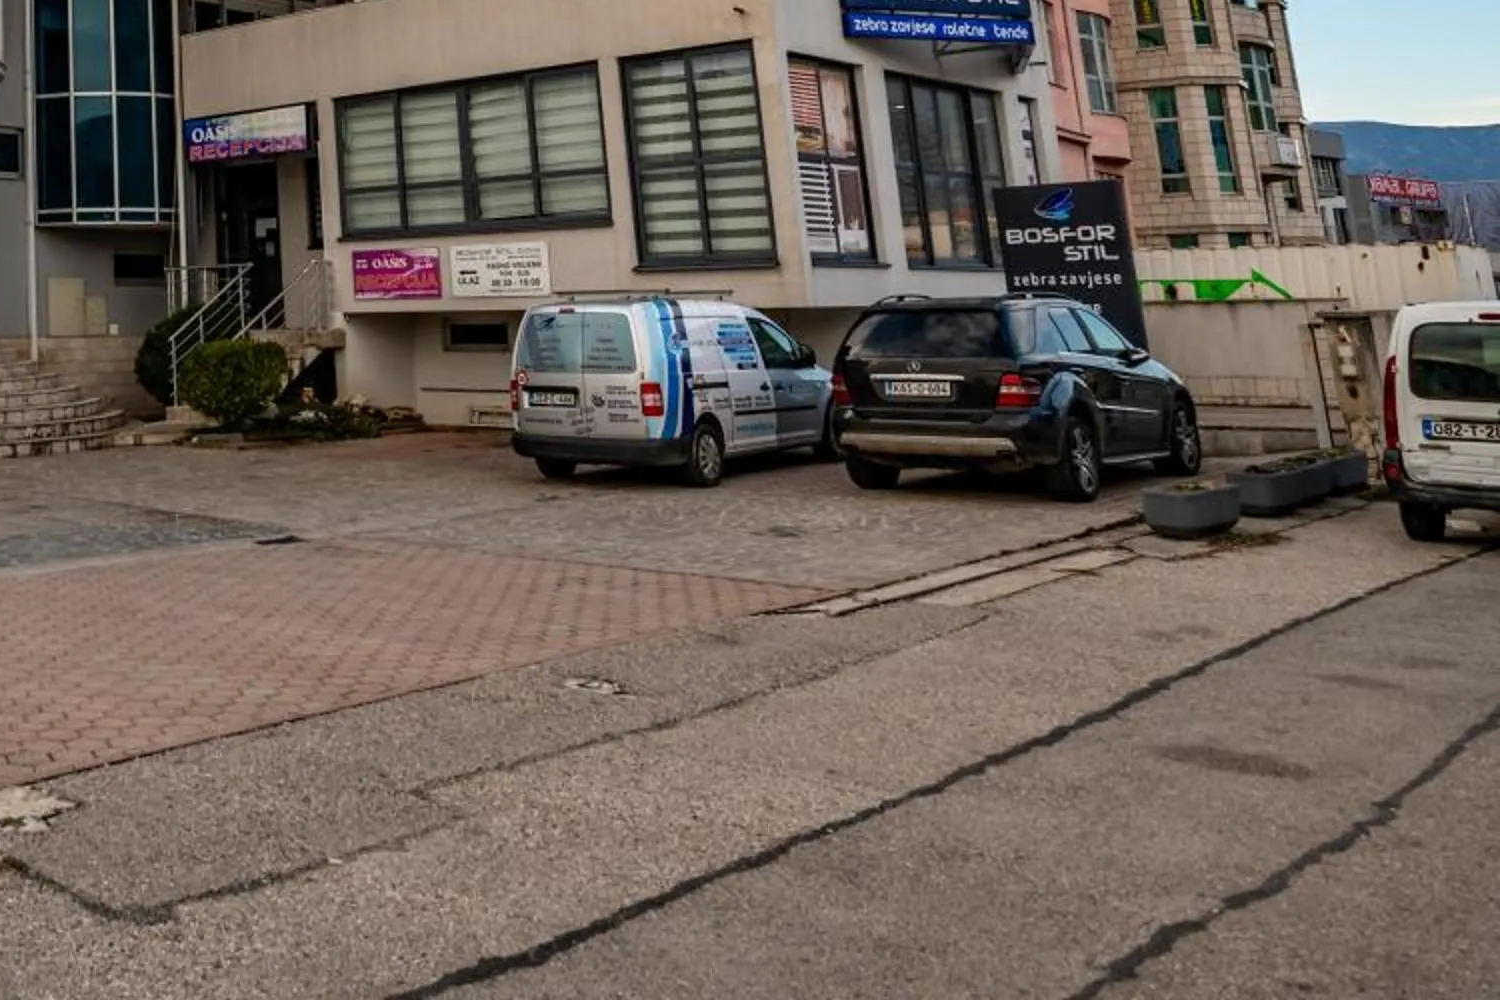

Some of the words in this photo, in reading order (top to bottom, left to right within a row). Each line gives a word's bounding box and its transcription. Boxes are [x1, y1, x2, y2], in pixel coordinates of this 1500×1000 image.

[854, 16, 889, 32] zebra
[890, 19, 937, 36] zavjese
[943, 22, 987, 38] roletne
[993, 24, 1029, 40] tende
[1005, 225, 1116, 245] BOSFOR
[1064, 244, 1120, 261] STIL
[372, 256, 408, 269] OASIS
[1013, 271, 1057, 287] zebra
[1059, 270, 1122, 289] zavjese
